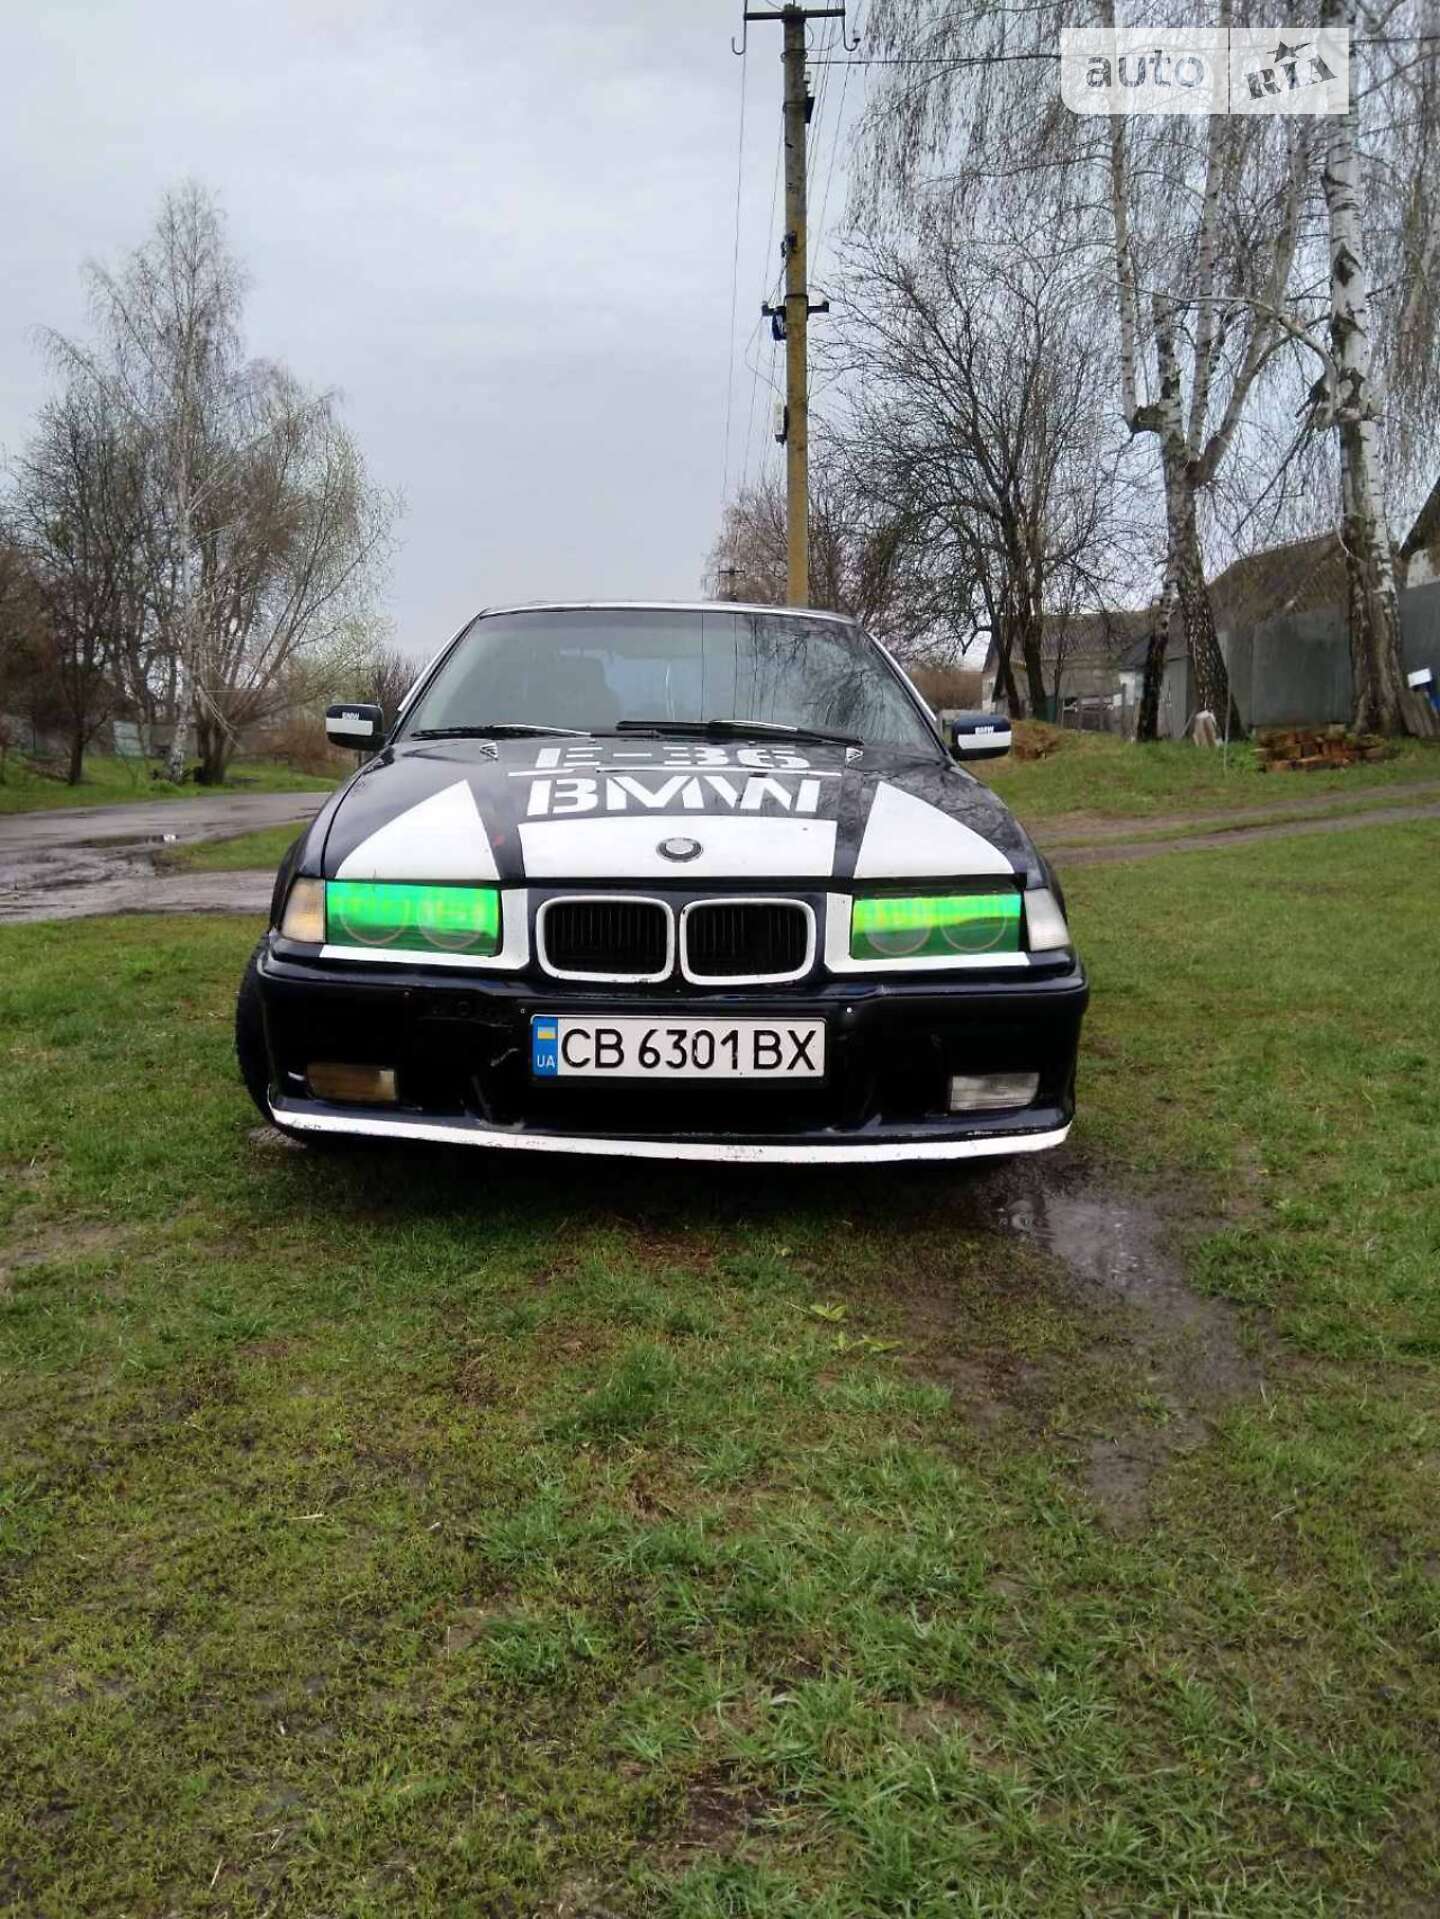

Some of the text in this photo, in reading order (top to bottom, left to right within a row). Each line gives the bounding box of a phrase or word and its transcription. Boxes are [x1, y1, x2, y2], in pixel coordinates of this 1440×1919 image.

[534, 746, 811, 769] E-36
[527, 775, 821, 816] BMW
[537, 1054, 555, 1067] UA
[561, 1028, 817, 1071] CB 6301 BX
